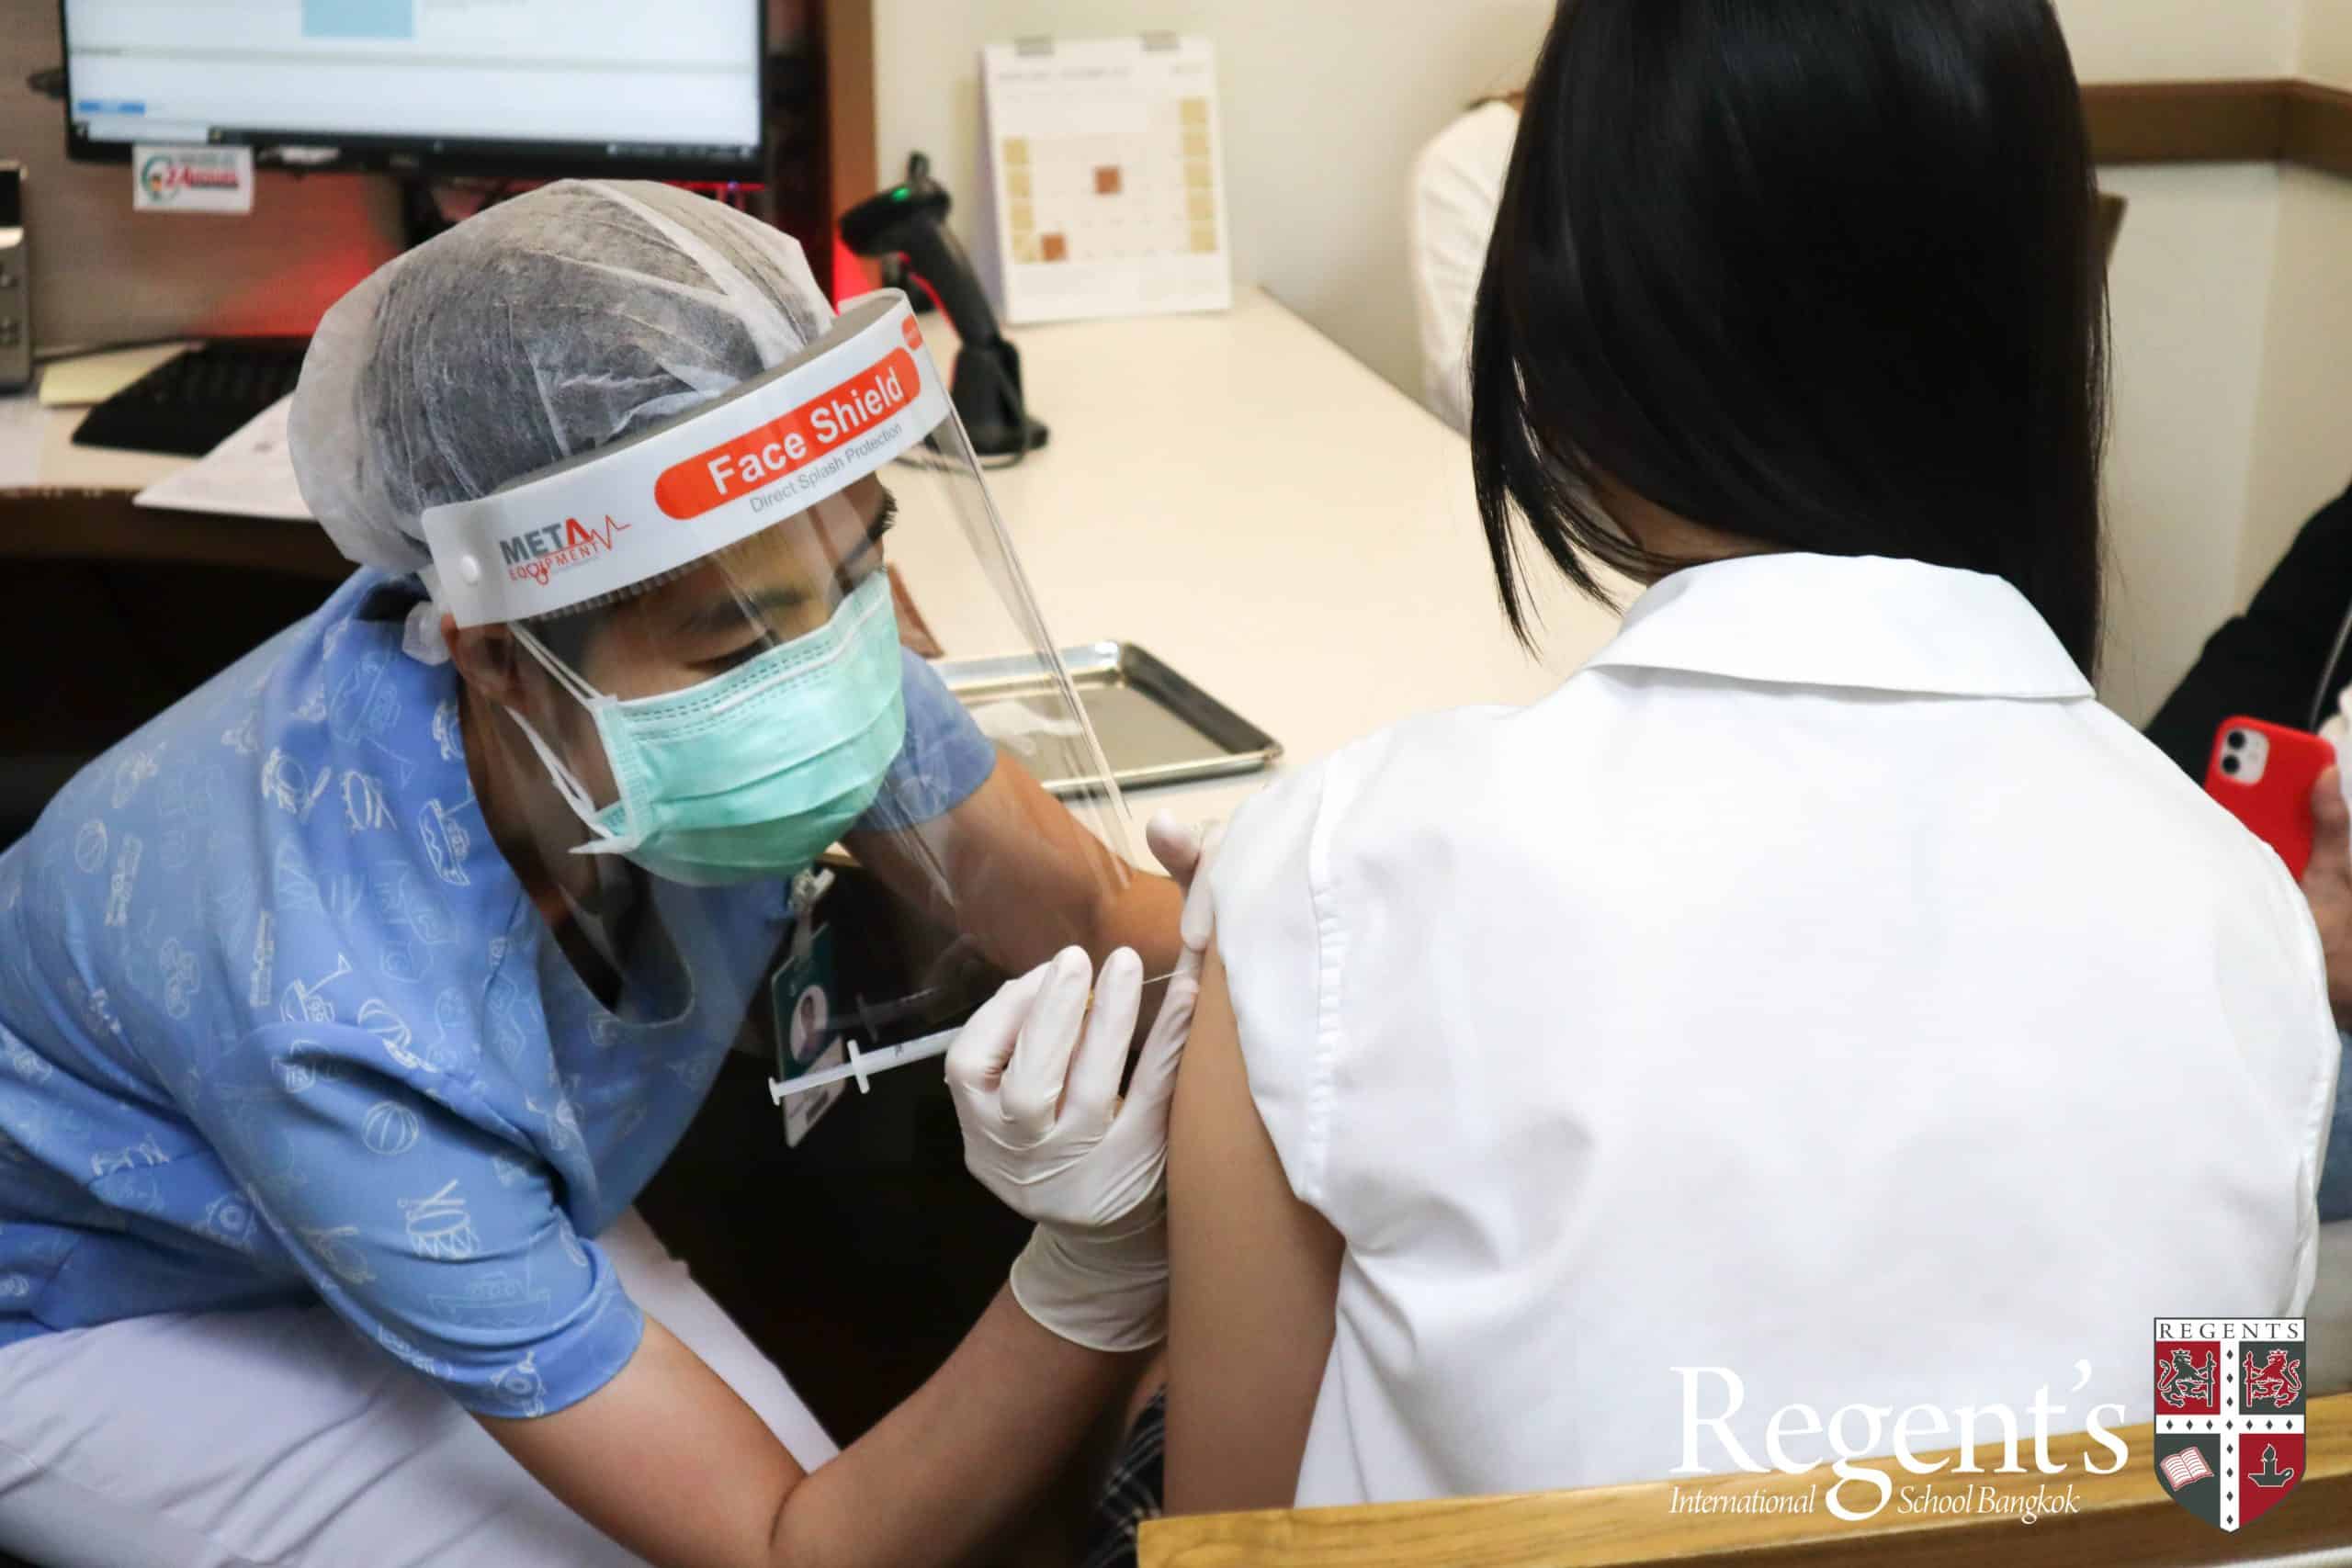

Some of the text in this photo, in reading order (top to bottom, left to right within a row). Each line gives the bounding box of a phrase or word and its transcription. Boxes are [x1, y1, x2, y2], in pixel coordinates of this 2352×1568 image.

[707, 367, 905, 495] Face Shield
[750, 423, 903, 513] Direct Splash Protection
[499, 517, 593, 565] META
